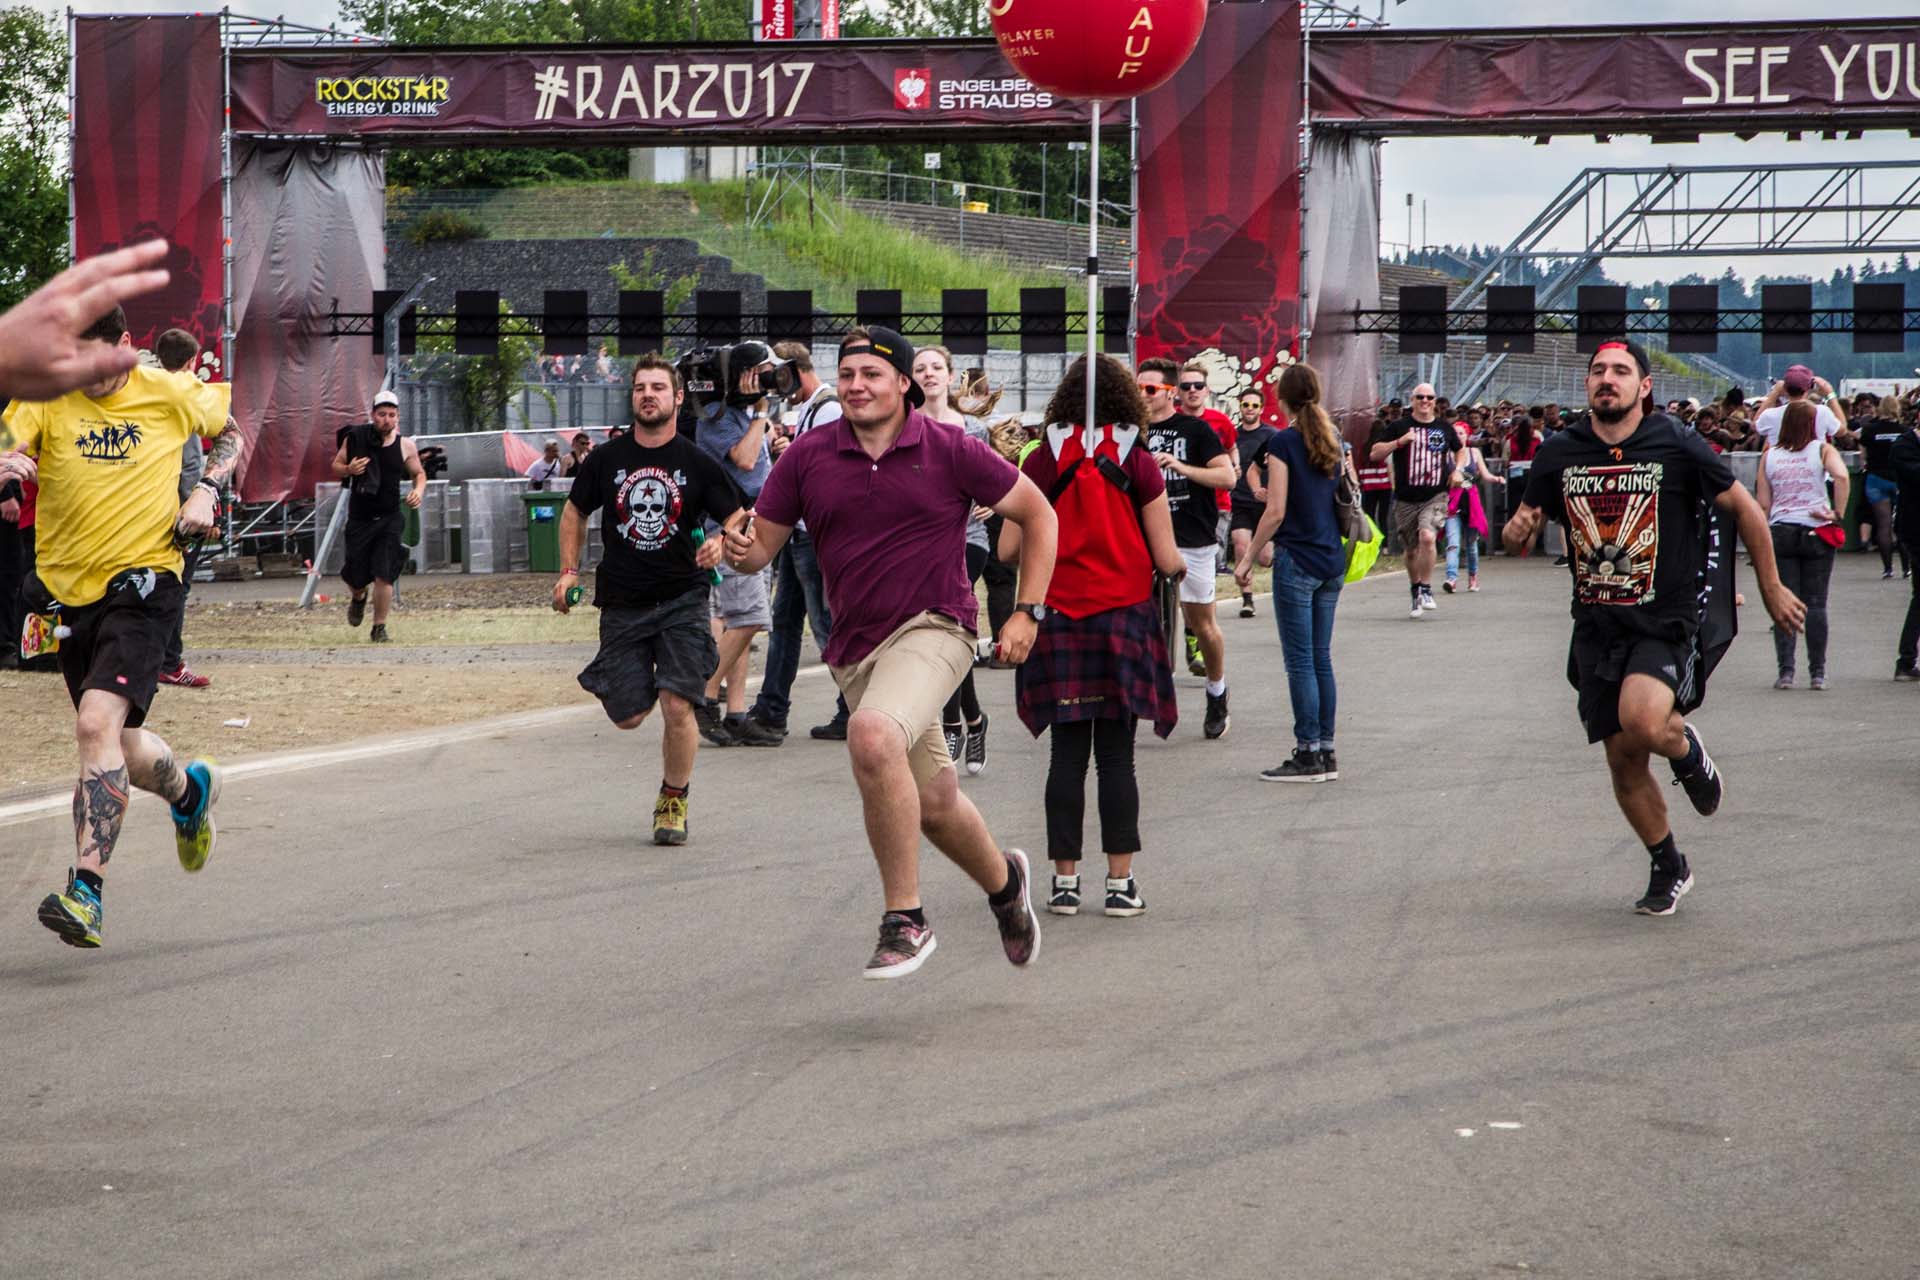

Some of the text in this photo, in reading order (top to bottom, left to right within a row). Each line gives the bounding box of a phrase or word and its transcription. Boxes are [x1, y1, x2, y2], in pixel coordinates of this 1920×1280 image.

[1682, 46, 1790, 104] SEE
[535, 62, 815, 120] #RAR2017
[939, 79, 1038, 92] ENGELBE
[328, 102, 437, 114] ENERGY DRINK
[939, 92, 1053, 109] STRAUSS
[1569, 475, 1605, 493] ROCK
[1618, 473, 1653, 492] RING
